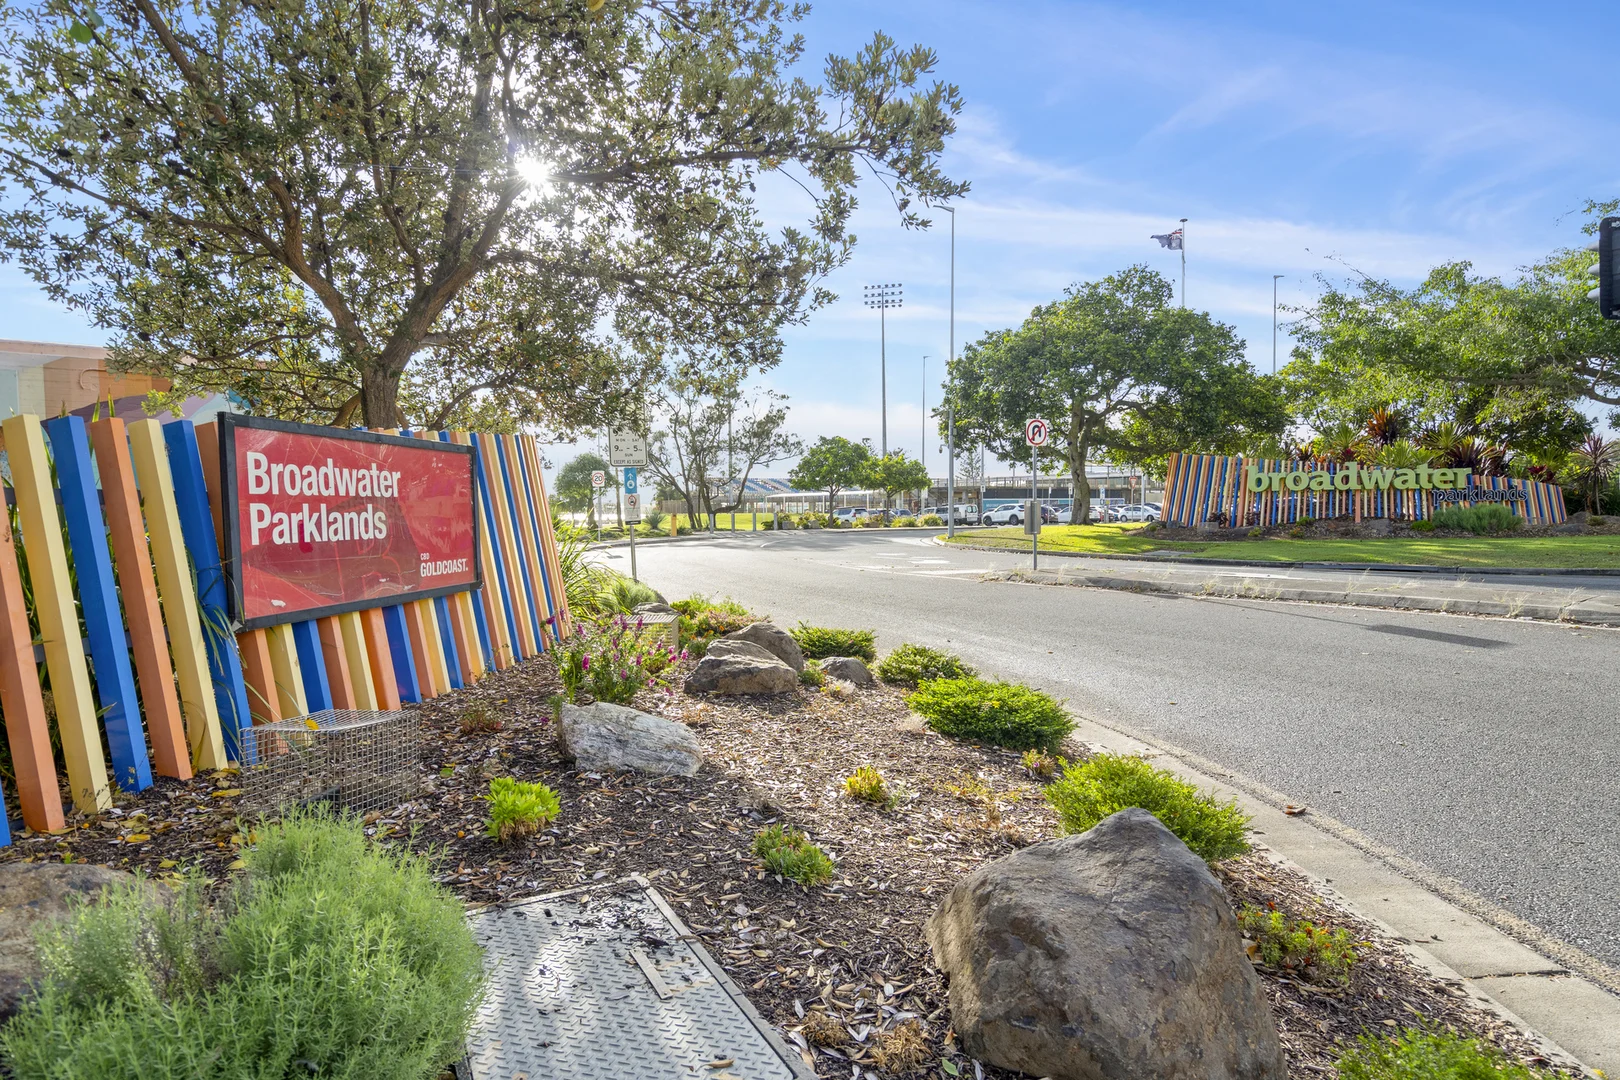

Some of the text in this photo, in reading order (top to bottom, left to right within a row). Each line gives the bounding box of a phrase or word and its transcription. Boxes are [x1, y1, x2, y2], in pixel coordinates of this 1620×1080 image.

[247, 452, 400, 497] Broadwater
[1245, 461, 1472, 493] broadwater
[1432, 484, 1528, 506] parklands
[249, 503, 387, 546] Parklands
